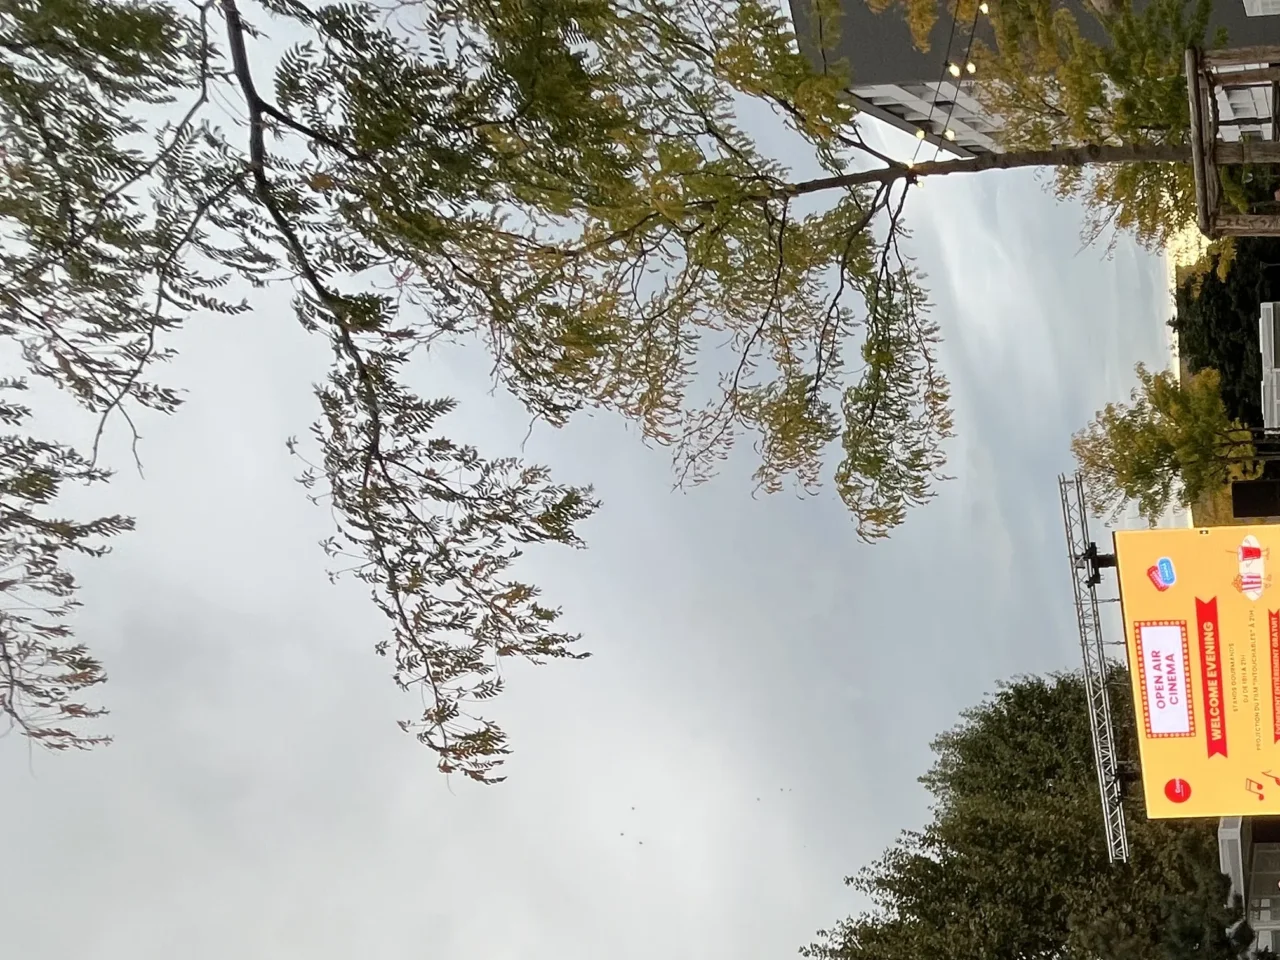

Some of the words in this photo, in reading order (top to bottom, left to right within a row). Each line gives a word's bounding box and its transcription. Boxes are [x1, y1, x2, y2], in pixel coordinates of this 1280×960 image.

[1151, 650, 1162, 671] AIR
[1203, 622, 1217, 677] EVENING
[1154, 675, 1166, 709] OPEN
[1165, 654, 1179, 705] CINEMA
[1207, 680, 1222, 741] WELCOME
[1254, 702, 1260, 711] DU
